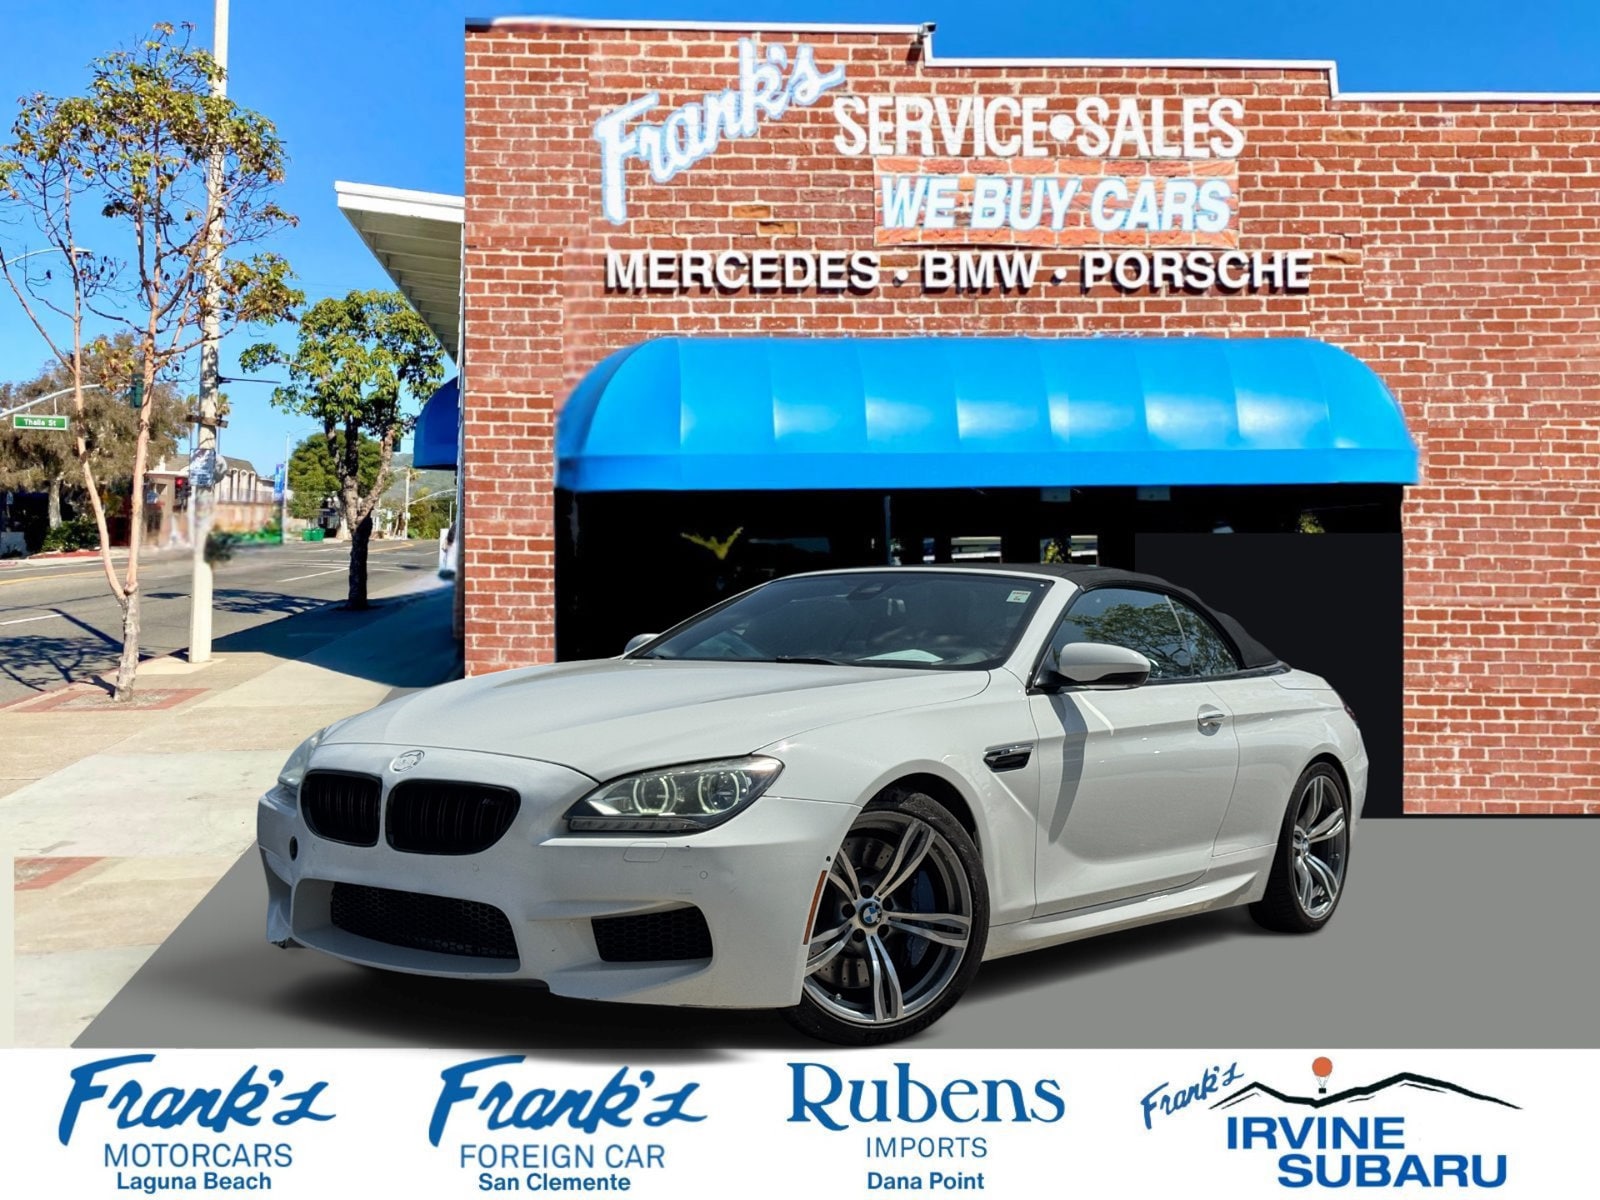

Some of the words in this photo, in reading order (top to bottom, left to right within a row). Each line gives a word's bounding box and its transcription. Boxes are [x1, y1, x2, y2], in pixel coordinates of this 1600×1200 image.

[593, 38, 847, 226] Frank's
[832, 96, 1050, 157] SERVICE
[1075, 97, 1246, 158] SALES
[880, 172, 962, 229] WE
[970, 174, 1081, 231] BUY
[1089, 176, 1234, 233] CARS
[605, 250, 881, 292] MERCEDES
[924, 250, 1041, 291] BMW
[1082, 250, 1312, 291] PORSCHE
[48, 418, 57, 427] St
